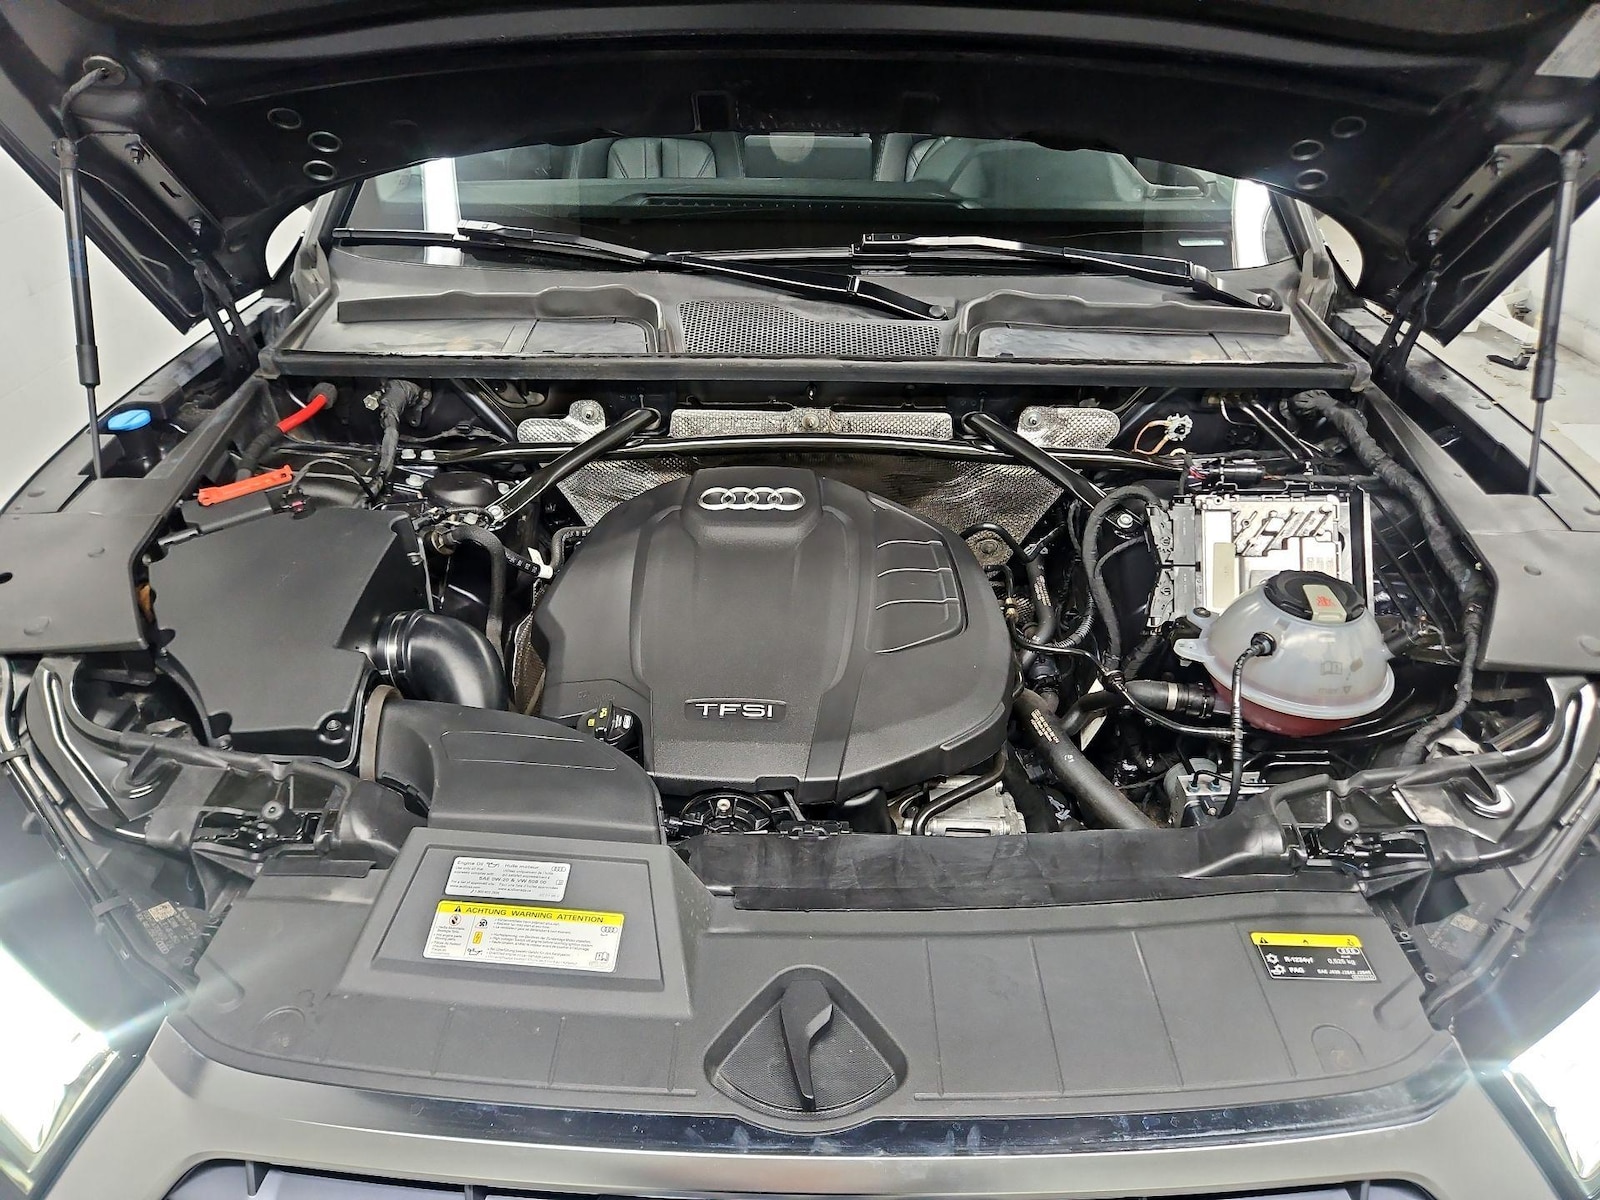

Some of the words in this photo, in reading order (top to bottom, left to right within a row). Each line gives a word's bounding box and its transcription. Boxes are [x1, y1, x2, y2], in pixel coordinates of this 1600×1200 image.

[695, 703, 774, 718] TFSI
[465, 907, 507, 916] ACHTUNG
[511, 911, 553, 920] WARNING
[556, 912, 604, 923] ATTENTION
